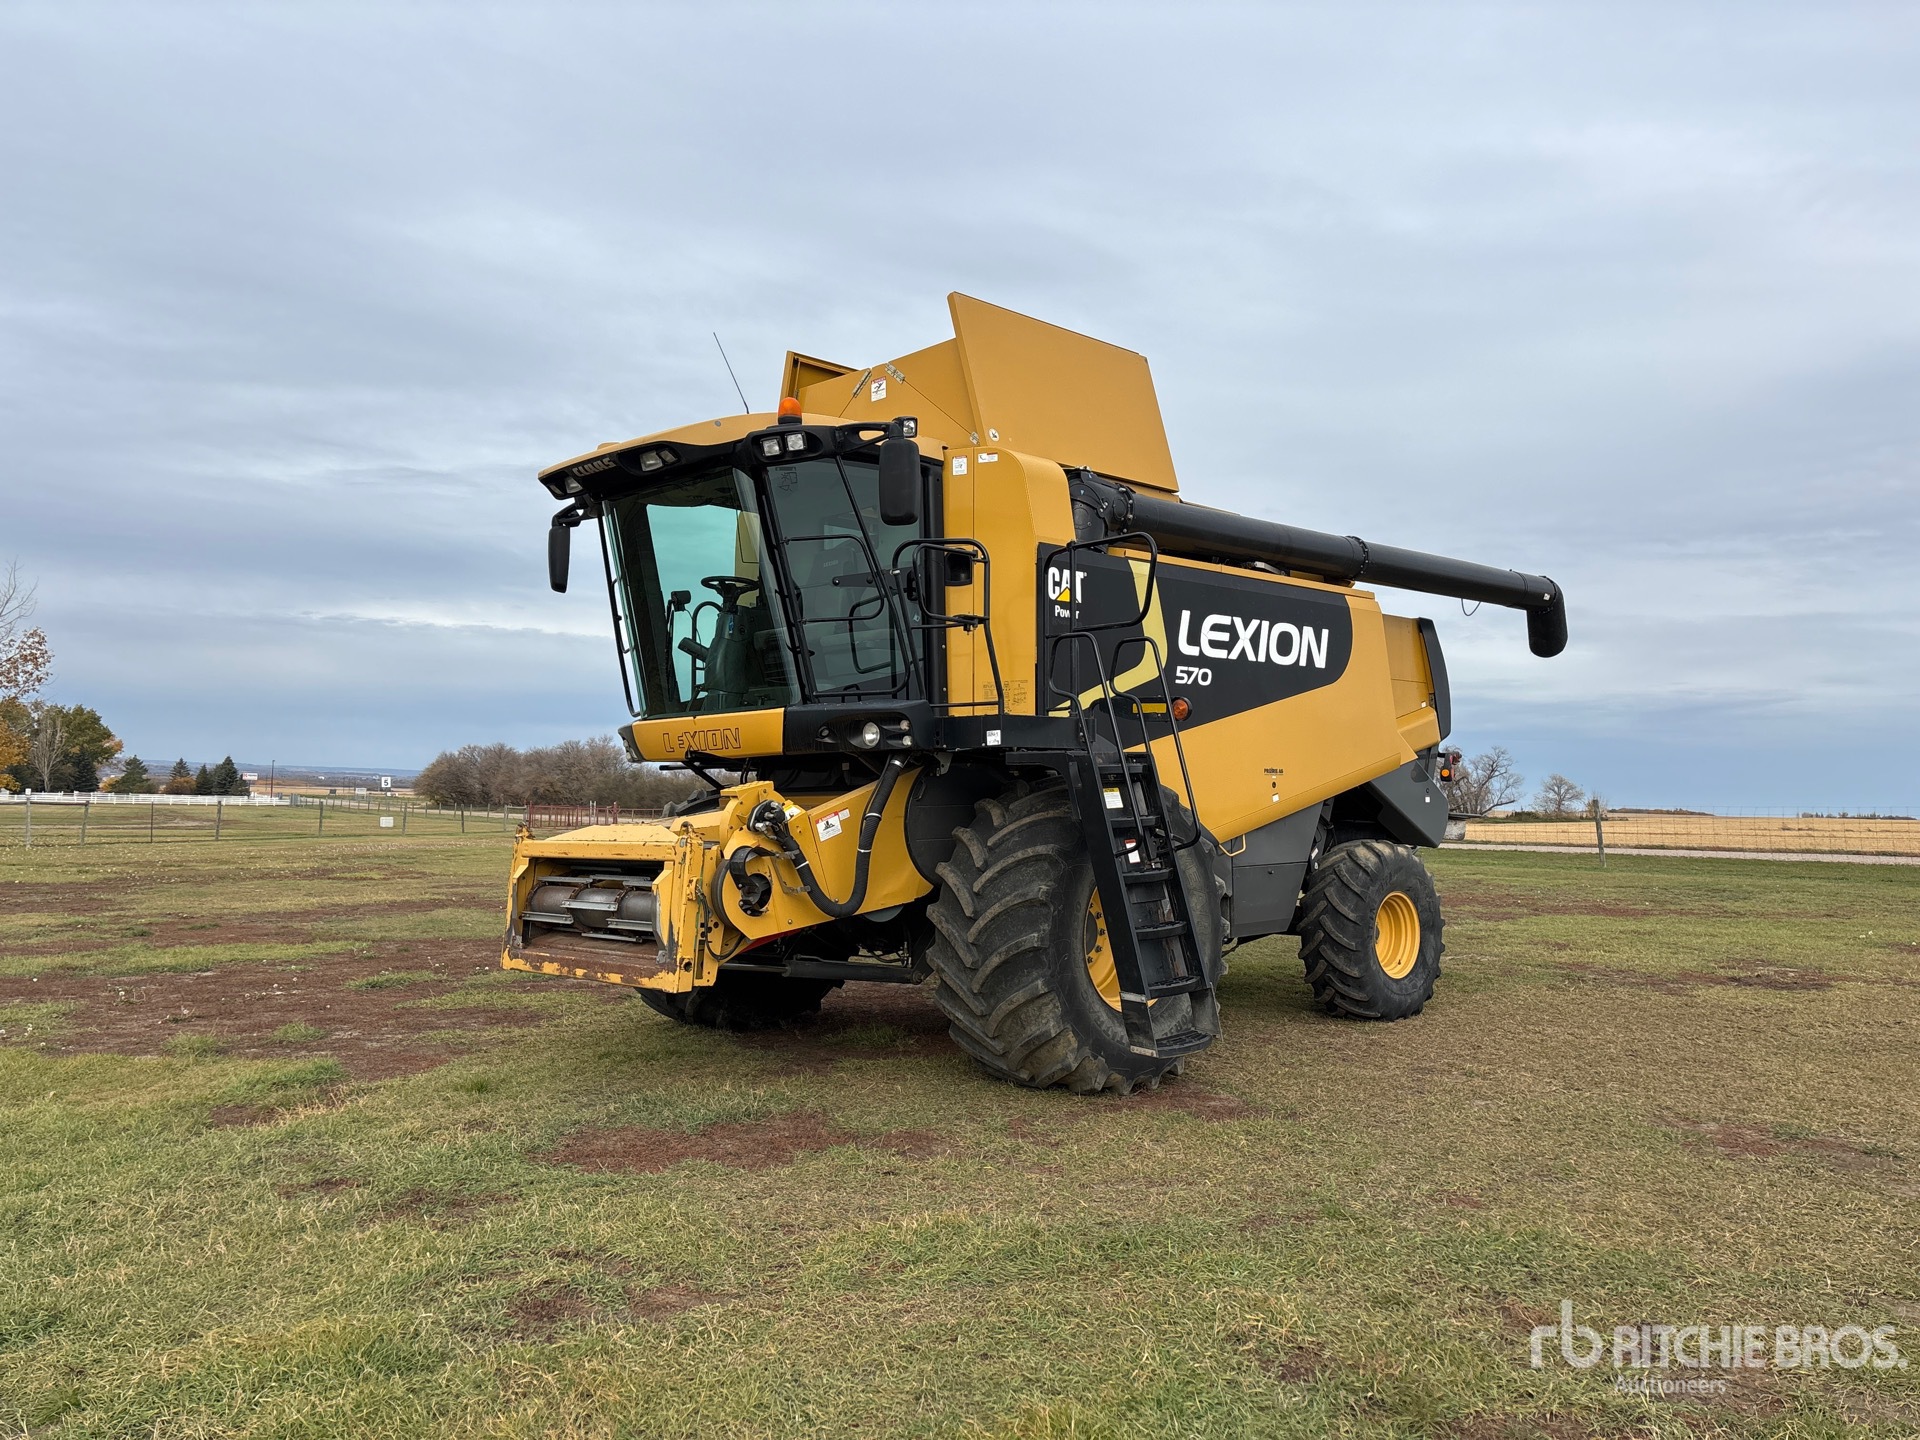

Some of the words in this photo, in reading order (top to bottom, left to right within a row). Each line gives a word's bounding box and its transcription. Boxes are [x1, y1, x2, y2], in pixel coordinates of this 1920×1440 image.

[572, 457, 617, 477] CLAAS
[1054, 605, 1080, 619] Powr
[1178, 609, 1329, 669] LEXION
[1175, 665, 1212, 686] 570
